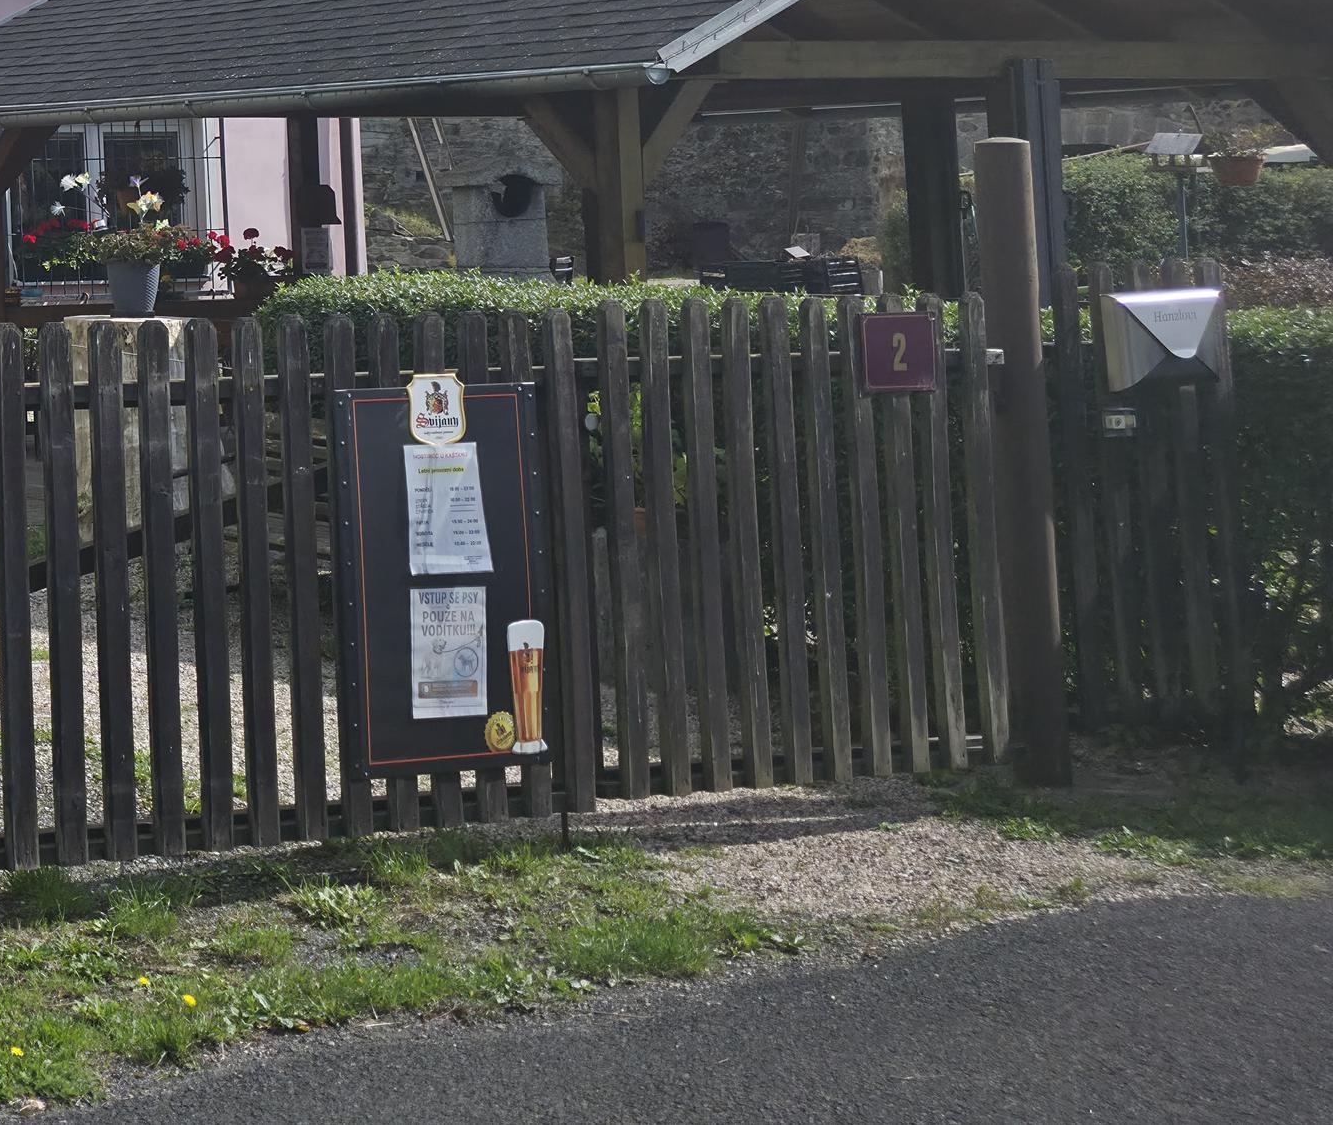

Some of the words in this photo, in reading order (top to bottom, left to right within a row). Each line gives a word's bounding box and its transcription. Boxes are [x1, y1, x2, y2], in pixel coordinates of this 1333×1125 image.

[892, 332, 908, 372] 2
[415, 412, 459, 428] Svijany
[418, 591, 447, 605] VSTUP
[449, 591, 460, 604] SE
[462, 591, 479, 604] PSY
[422, 610, 457, 623] POUZE
[460, 610, 475, 622] NA
